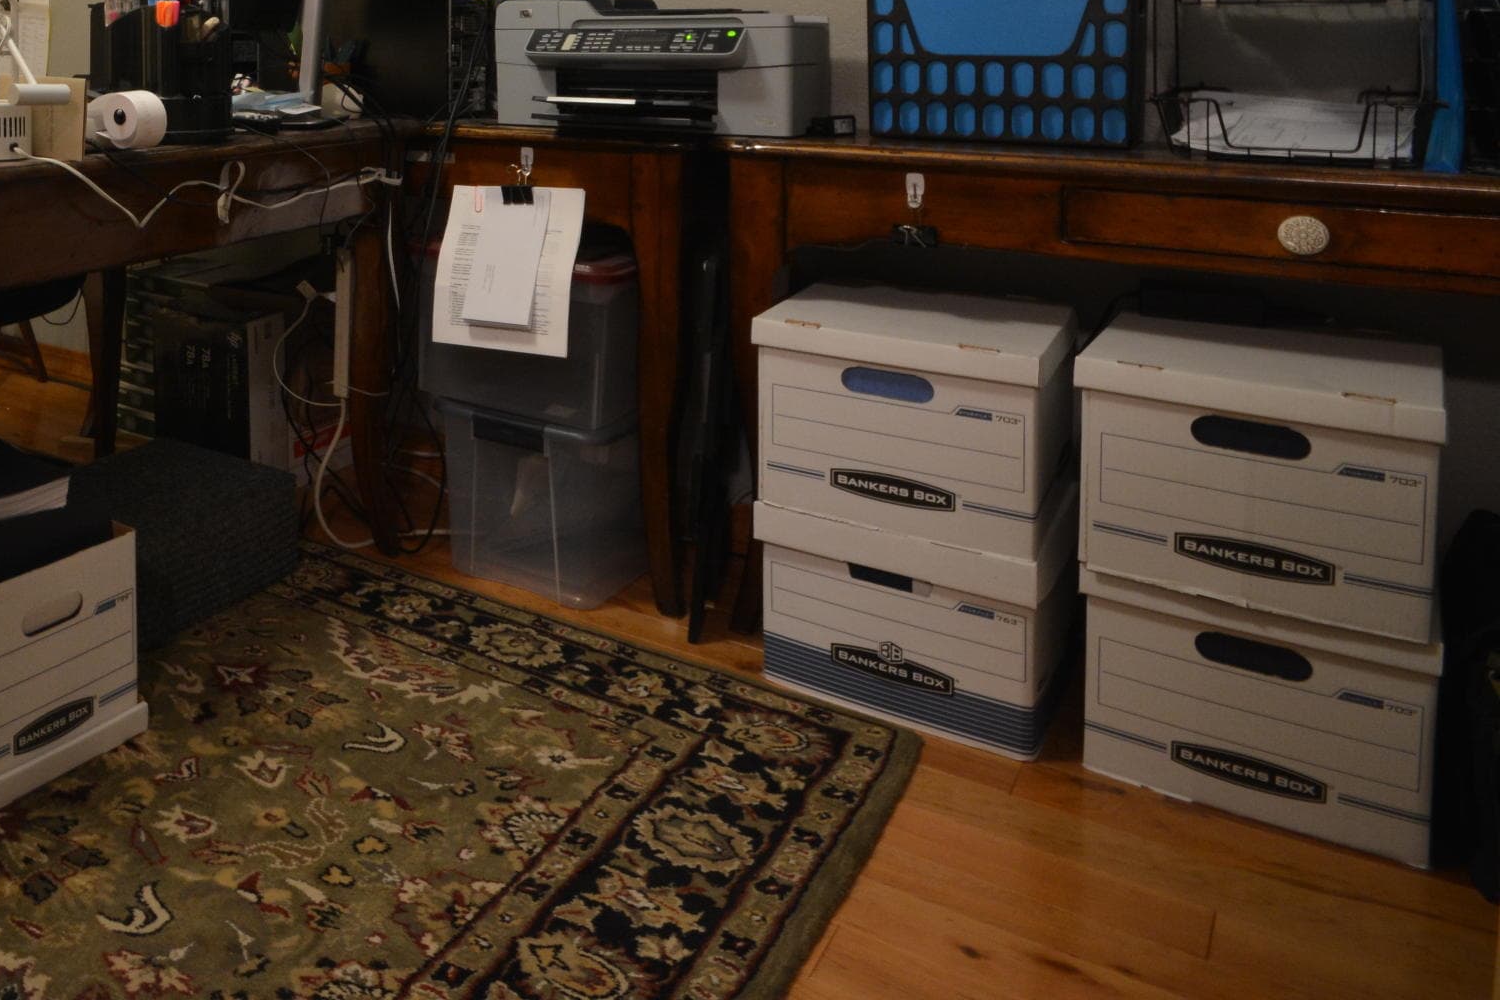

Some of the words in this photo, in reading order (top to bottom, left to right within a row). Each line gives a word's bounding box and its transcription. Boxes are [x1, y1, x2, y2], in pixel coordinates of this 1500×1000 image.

[837, 474, 910, 498] BANKERS
[914, 489, 947, 507] BOX
[1183, 538, 1277, 570] BANKERS
[1281, 559, 1325, 579] BOX
[838, 649, 909, 679] BANKERS
[912, 671, 946, 690] BOX
[18, 715, 67, 747] BANKERS
[67, 704, 90, 722] BOX
[1180, 748, 1270, 783] BANKERS
[1275, 776, 1317, 797] BOX
